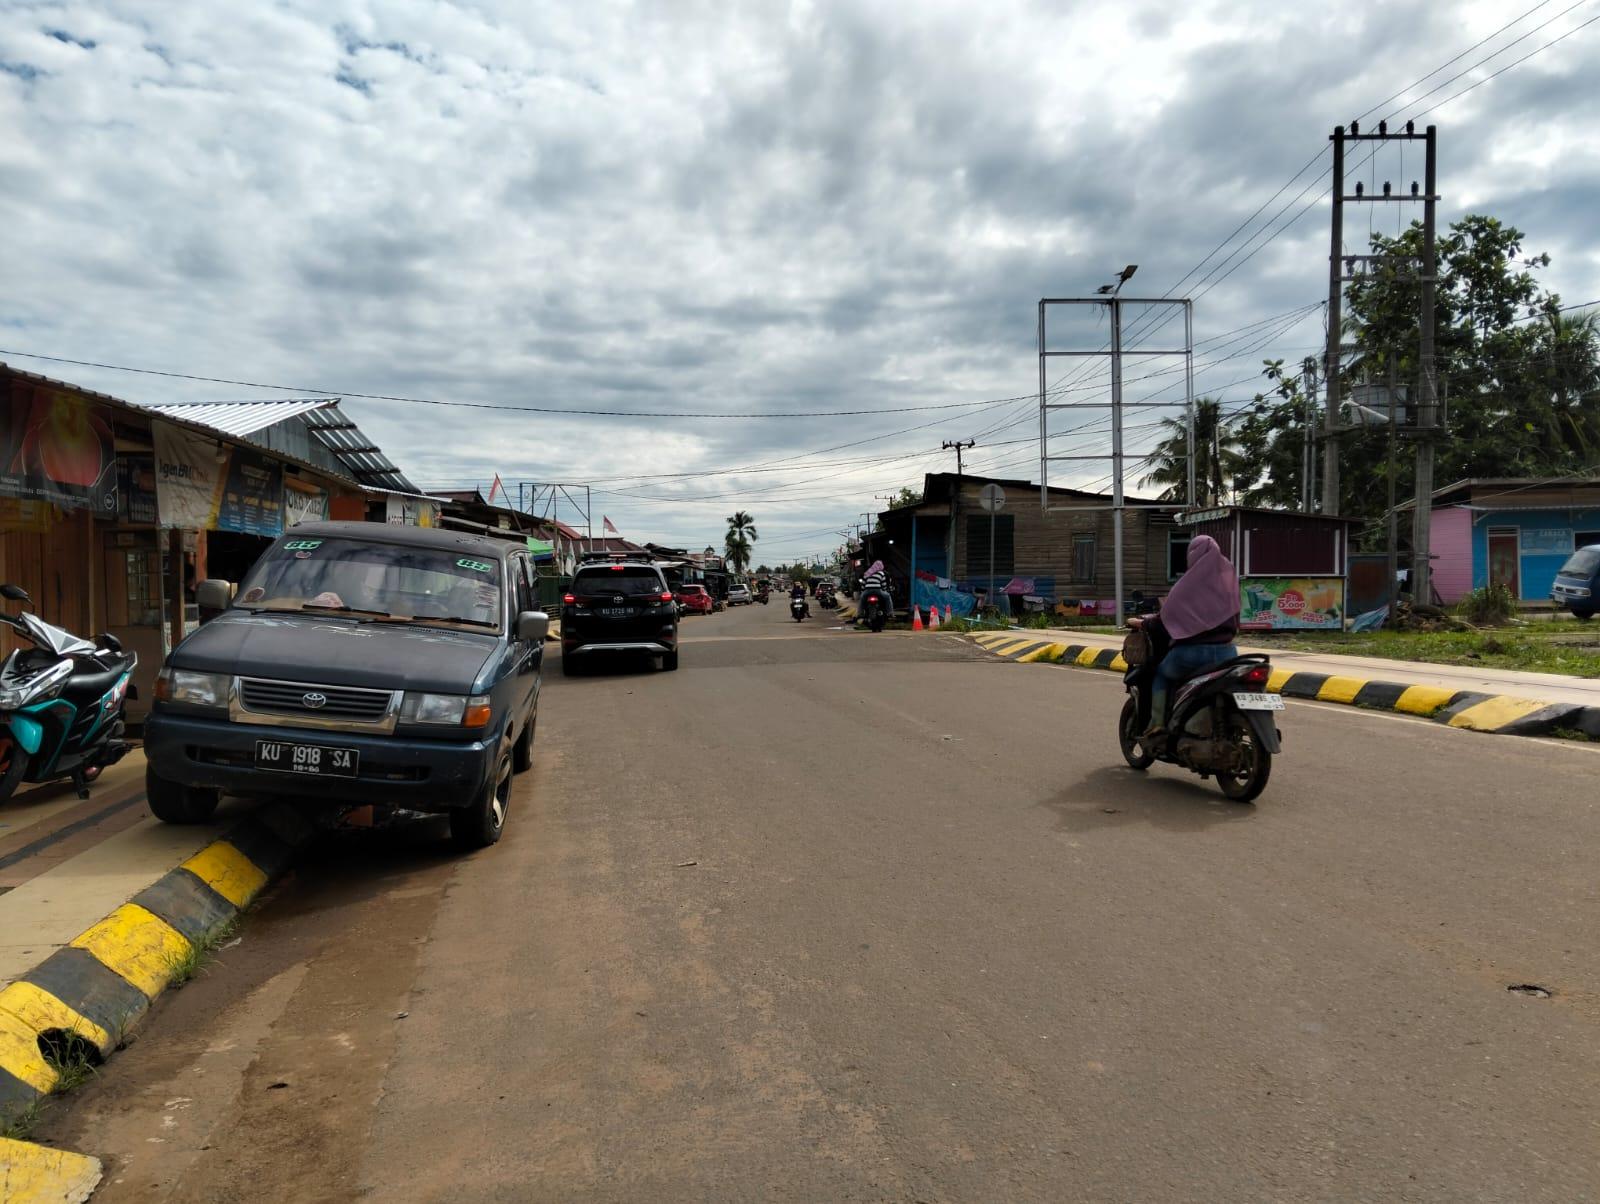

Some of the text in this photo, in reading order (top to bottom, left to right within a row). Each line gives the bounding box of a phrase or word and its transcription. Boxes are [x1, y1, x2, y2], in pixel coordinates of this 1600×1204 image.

[261, 743, 351, 767] KU 1918 SA
